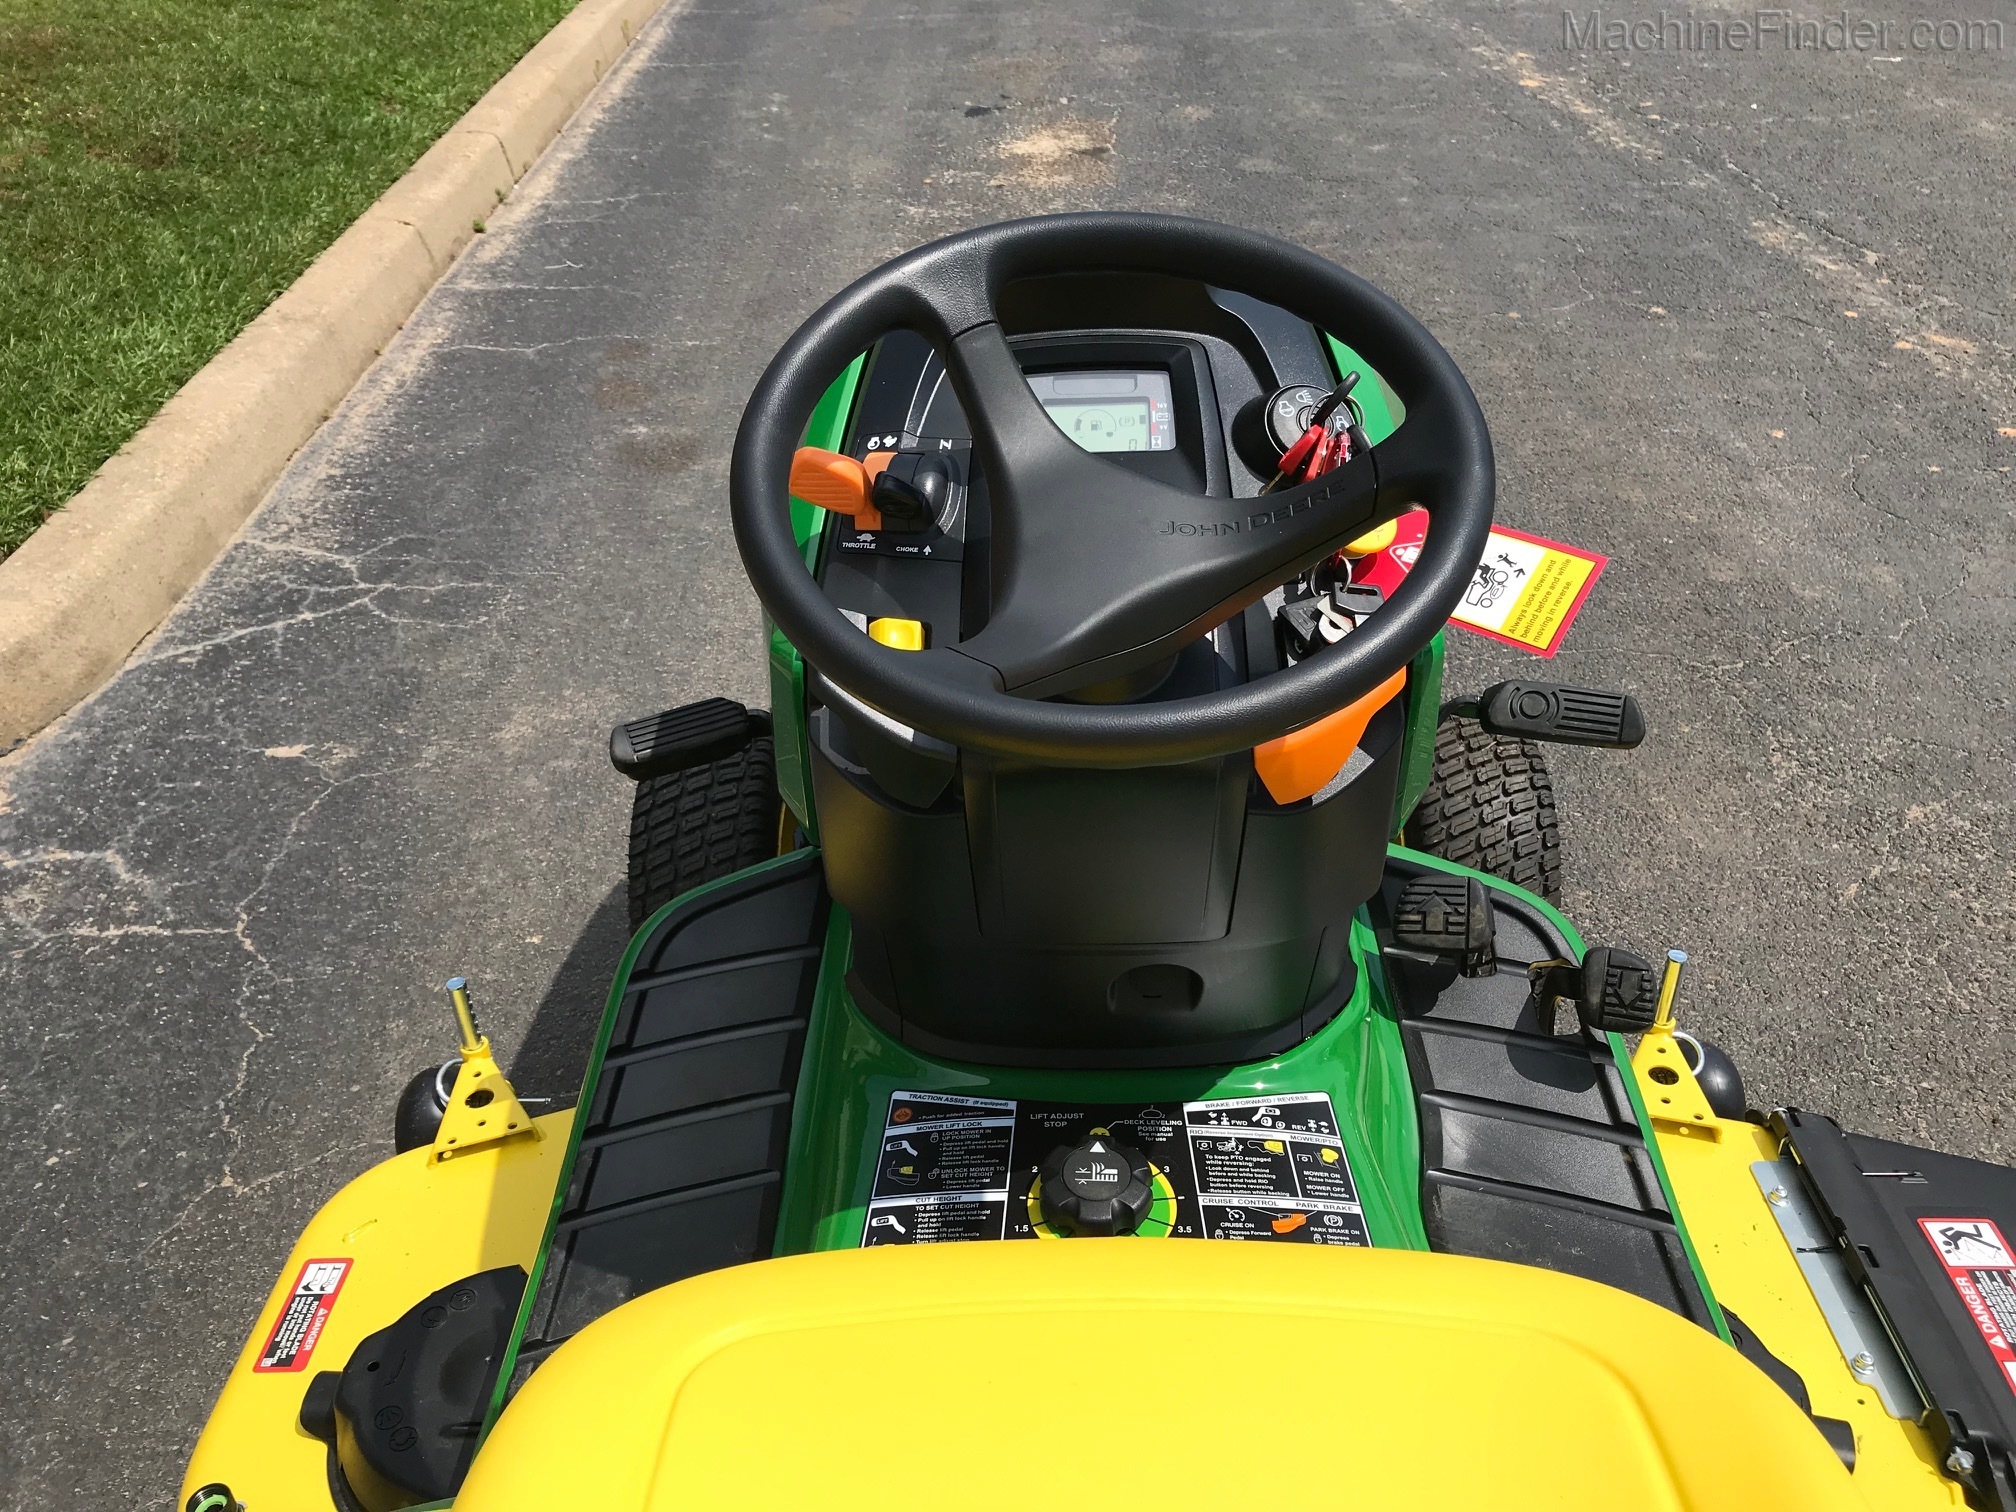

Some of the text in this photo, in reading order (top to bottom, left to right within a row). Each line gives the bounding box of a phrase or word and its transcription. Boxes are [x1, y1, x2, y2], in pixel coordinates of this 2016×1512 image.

[1158, 479, 1345, 536] JOHN DEERE
[1508, 560, 1556, 634] Always look down and
[1520, 558, 1572, 638] behind before and while
[1533, 581, 1573, 642] moving in reverse.
[908, 1094, 944, 1102] TRACTION
[944, 1096, 970, 1104] ASSIST
[916, 1123, 944, 1132] MOWER
[1290, 1134, 1339, 1145] MOWER/PTO
[1955, 1276, 1998, 1333] DANGER
[1976, 1283, 1993, 1306] BLADE
[288, 1300, 320, 1355] ROTATING BLADE
[302, 1316, 324, 1351] DANGER
[1990, 1306, 2014, 1343] ROTATING
